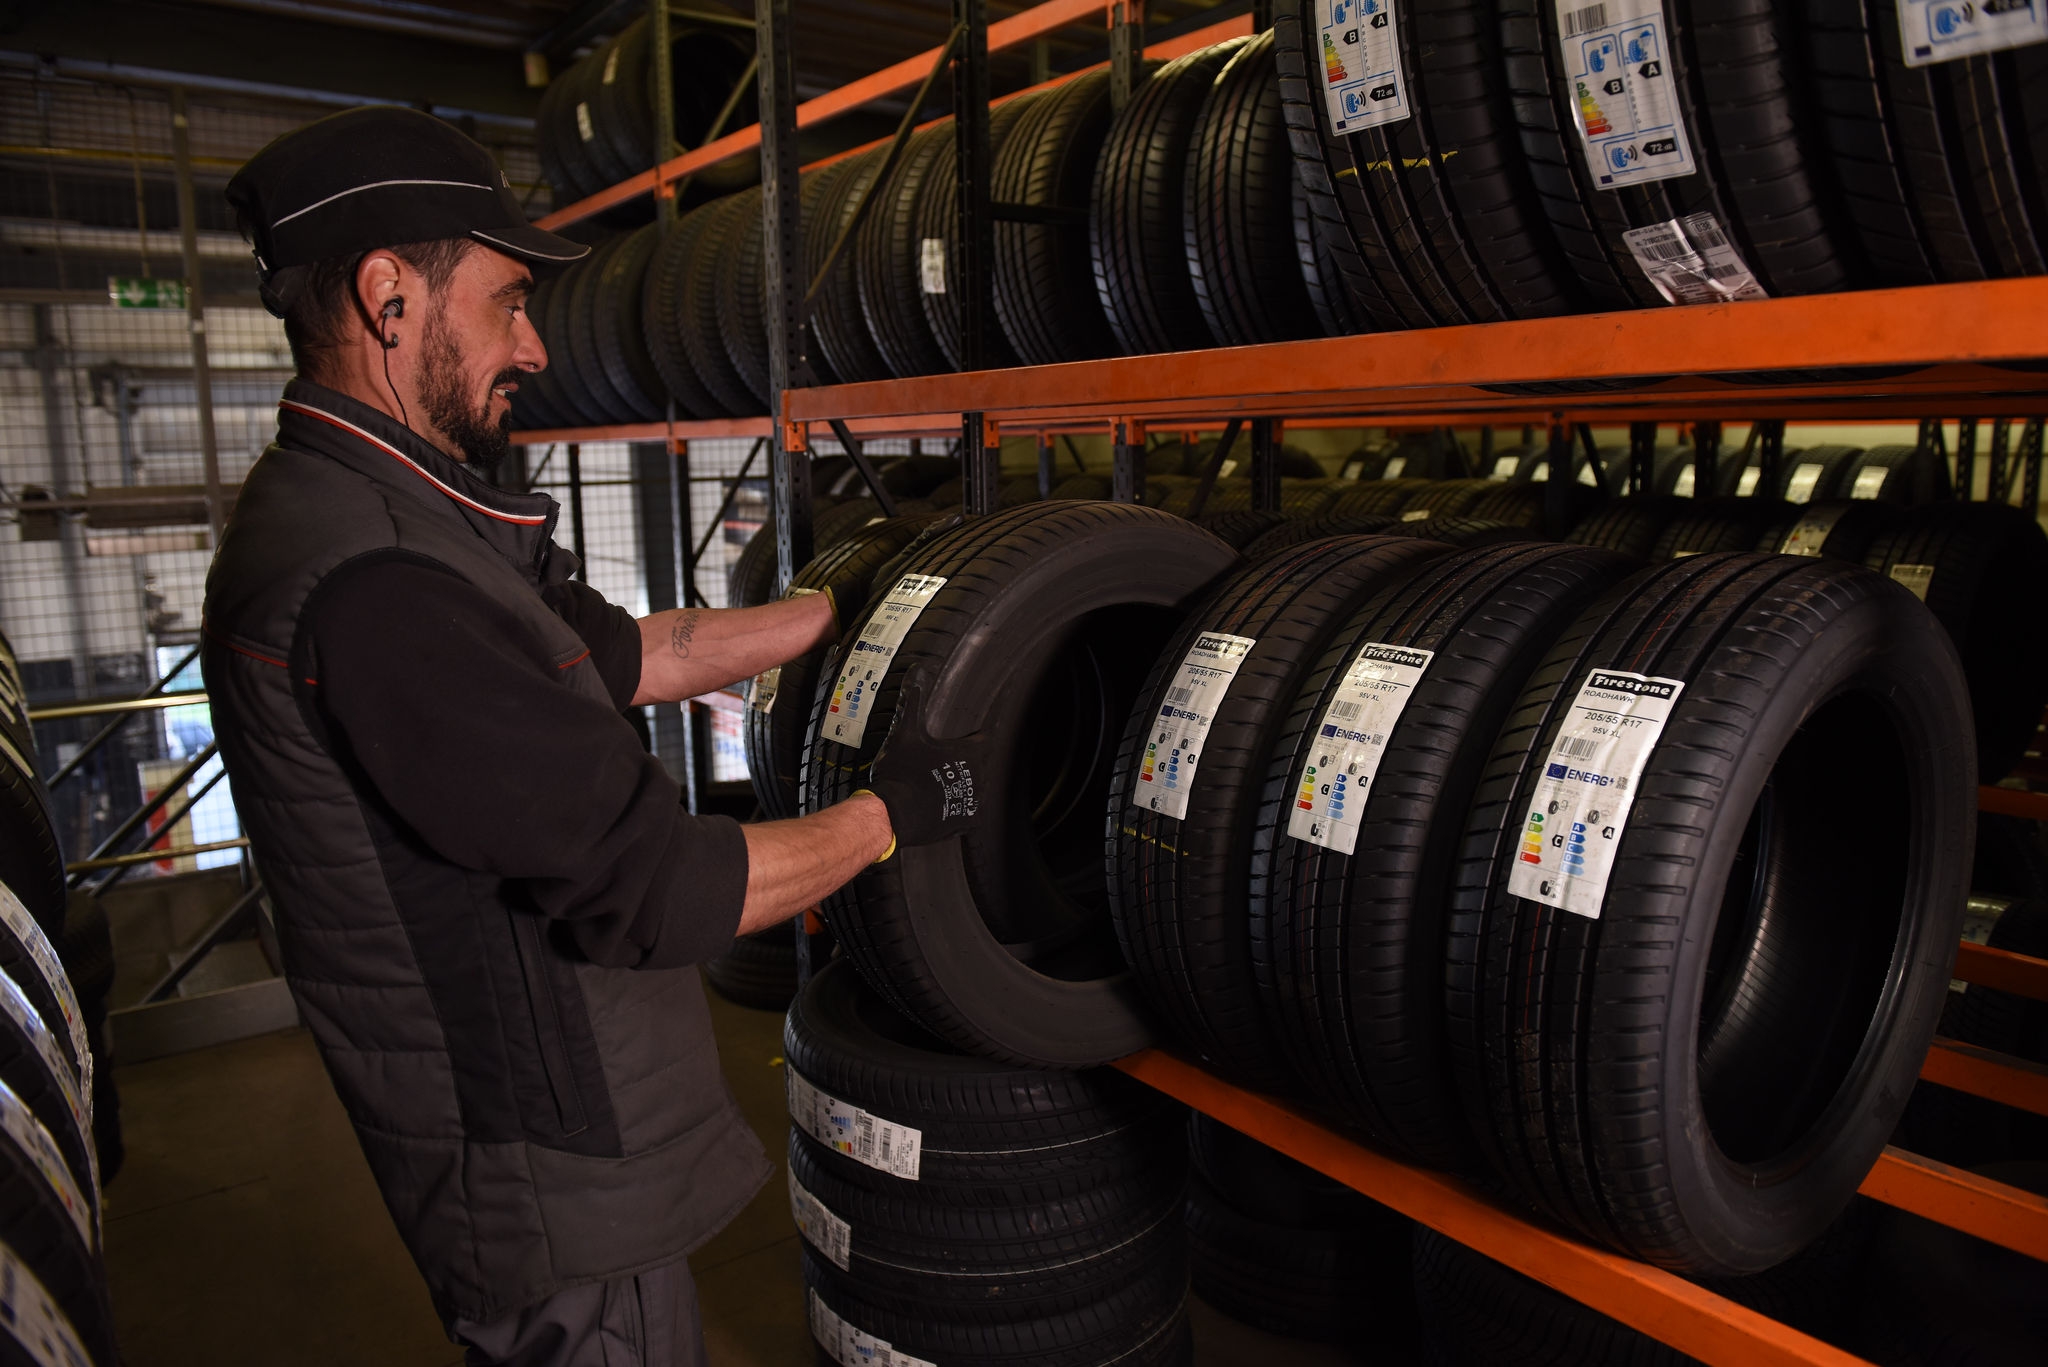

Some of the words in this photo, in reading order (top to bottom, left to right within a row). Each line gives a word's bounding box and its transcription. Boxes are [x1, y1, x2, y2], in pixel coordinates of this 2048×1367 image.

[1377, 16, 1386, 27] A
[1349, 32, 1357, 42] B
[1648, 64, 1658, 76] A
[1376, 89, 1386, 98] 72
[1611, 82, 1621, 93] B
[1199, 639, 1247, 653] Fires
[1191, 649, 1219, 659] ROADHAW
[1365, 650, 1424, 665] Firestone
[1208, 671, 1222, 679] R17
[1354, 679, 1380, 690] 205/55
[1380, 684, 1399, 693] R17
[1594, 675, 1671, 696] Firestone
[1583, 689, 1634, 704] ROADHAWK
[1584, 711, 1618, 724] 205/55
[1621, 718, 1642, 729] R17
[1335, 729, 1367, 743] ENERG
[1592, 726, 1608, 736] 95V
[1610, 730, 1621, 739] XL
[943, 762, 955, 779] 10
[959, 760, 974, 806] LEBON
[1567, 769, 1609, 787] ENERG
